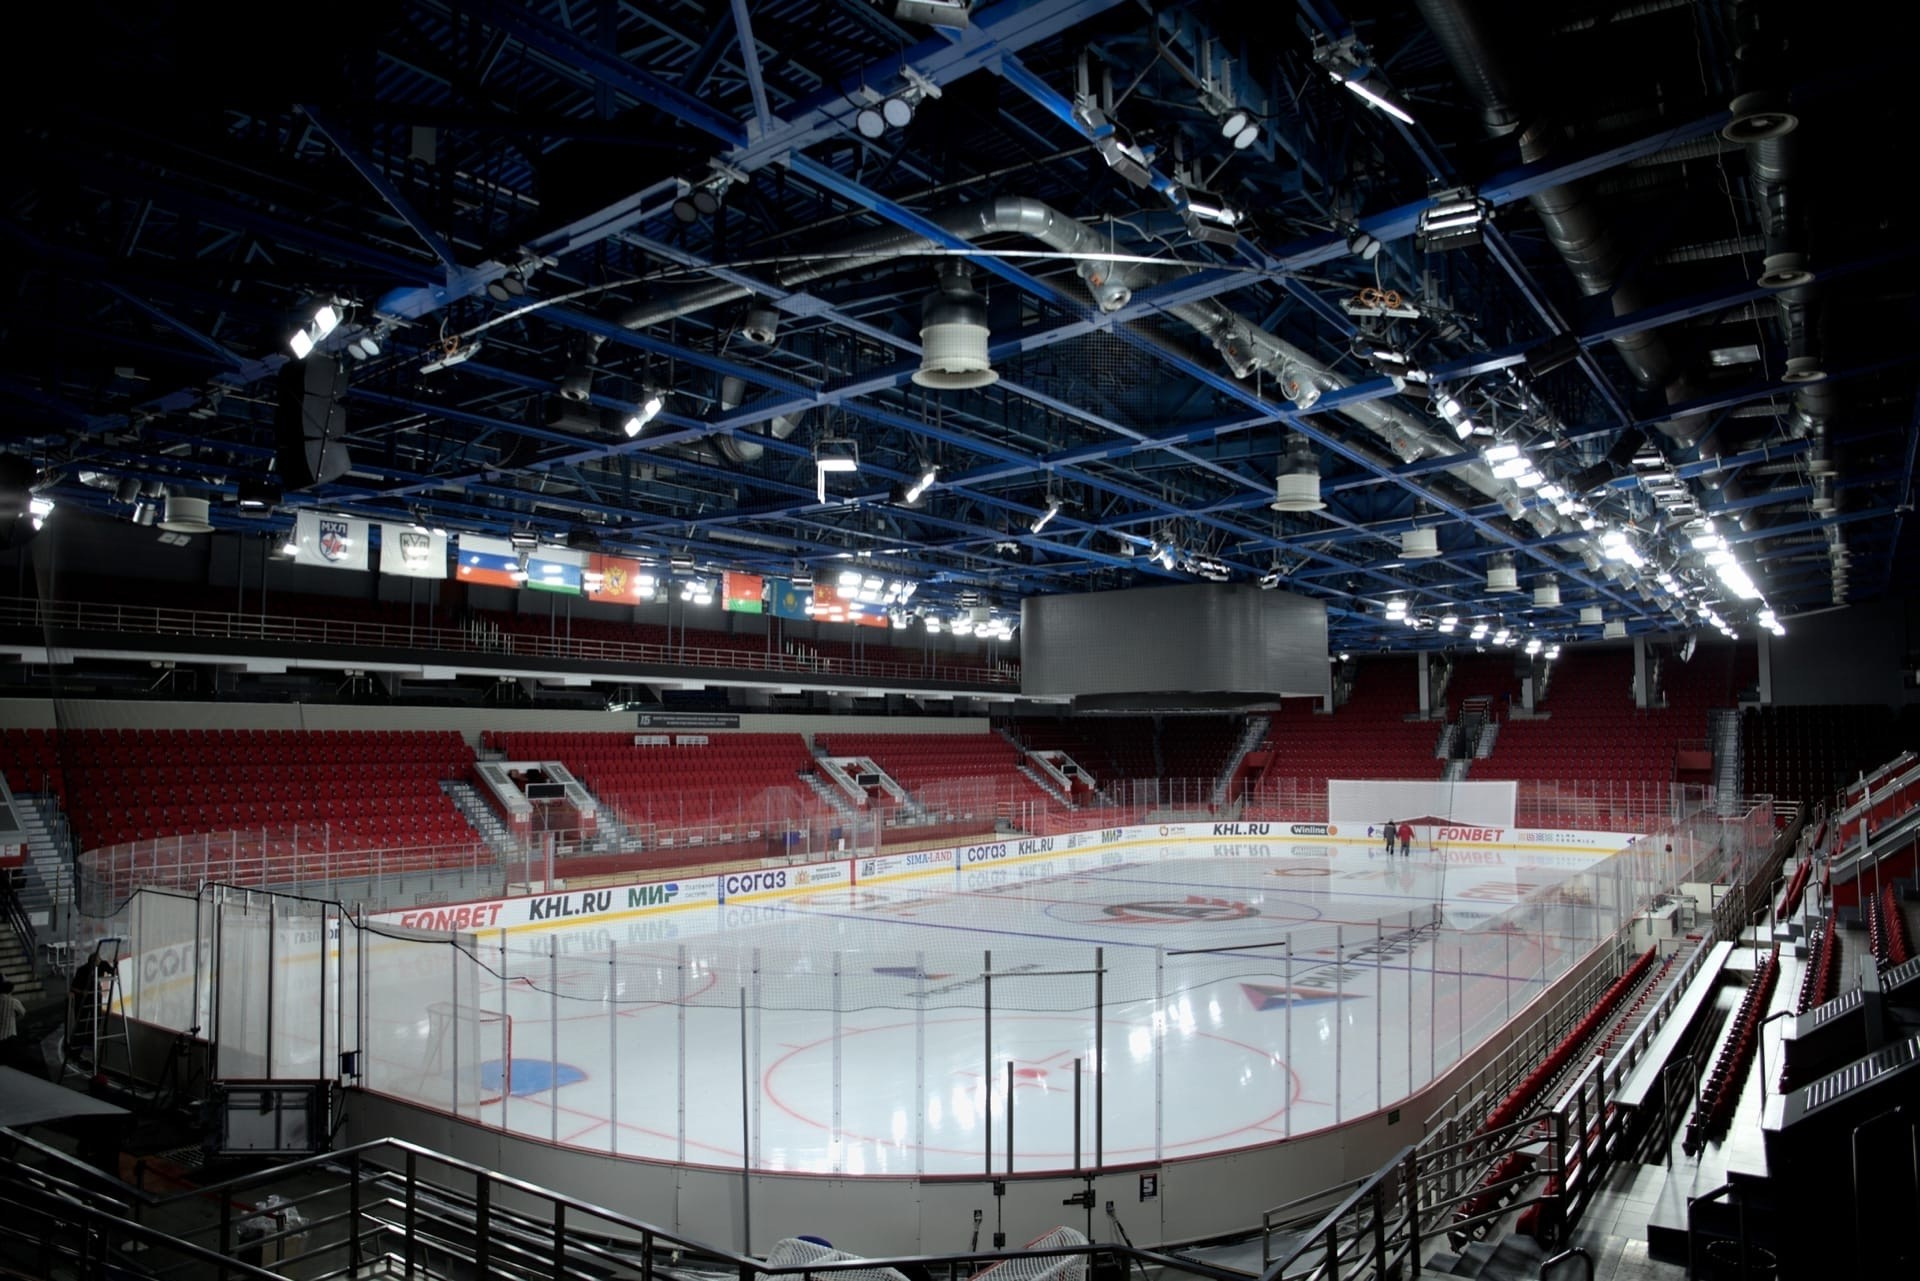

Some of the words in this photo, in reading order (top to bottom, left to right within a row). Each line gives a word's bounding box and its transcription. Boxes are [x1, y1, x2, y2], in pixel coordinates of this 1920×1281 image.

[321, 522, 347, 533] МХЛ
[1213, 823, 1270, 836] KHL.RU
[1293, 826, 1326, 835] Winline
[1437, 828, 1505, 842] FONBET
[1018, 837, 1054, 855] KHL.RU
[906, 850, 953, 866] SIMA-LAND
[628, 882, 679, 908] МИР
[529, 890, 612, 921] KHL.RU
[400, 903, 504, 931] FONBET
[1143, 1178, 1154, 1193] 5
